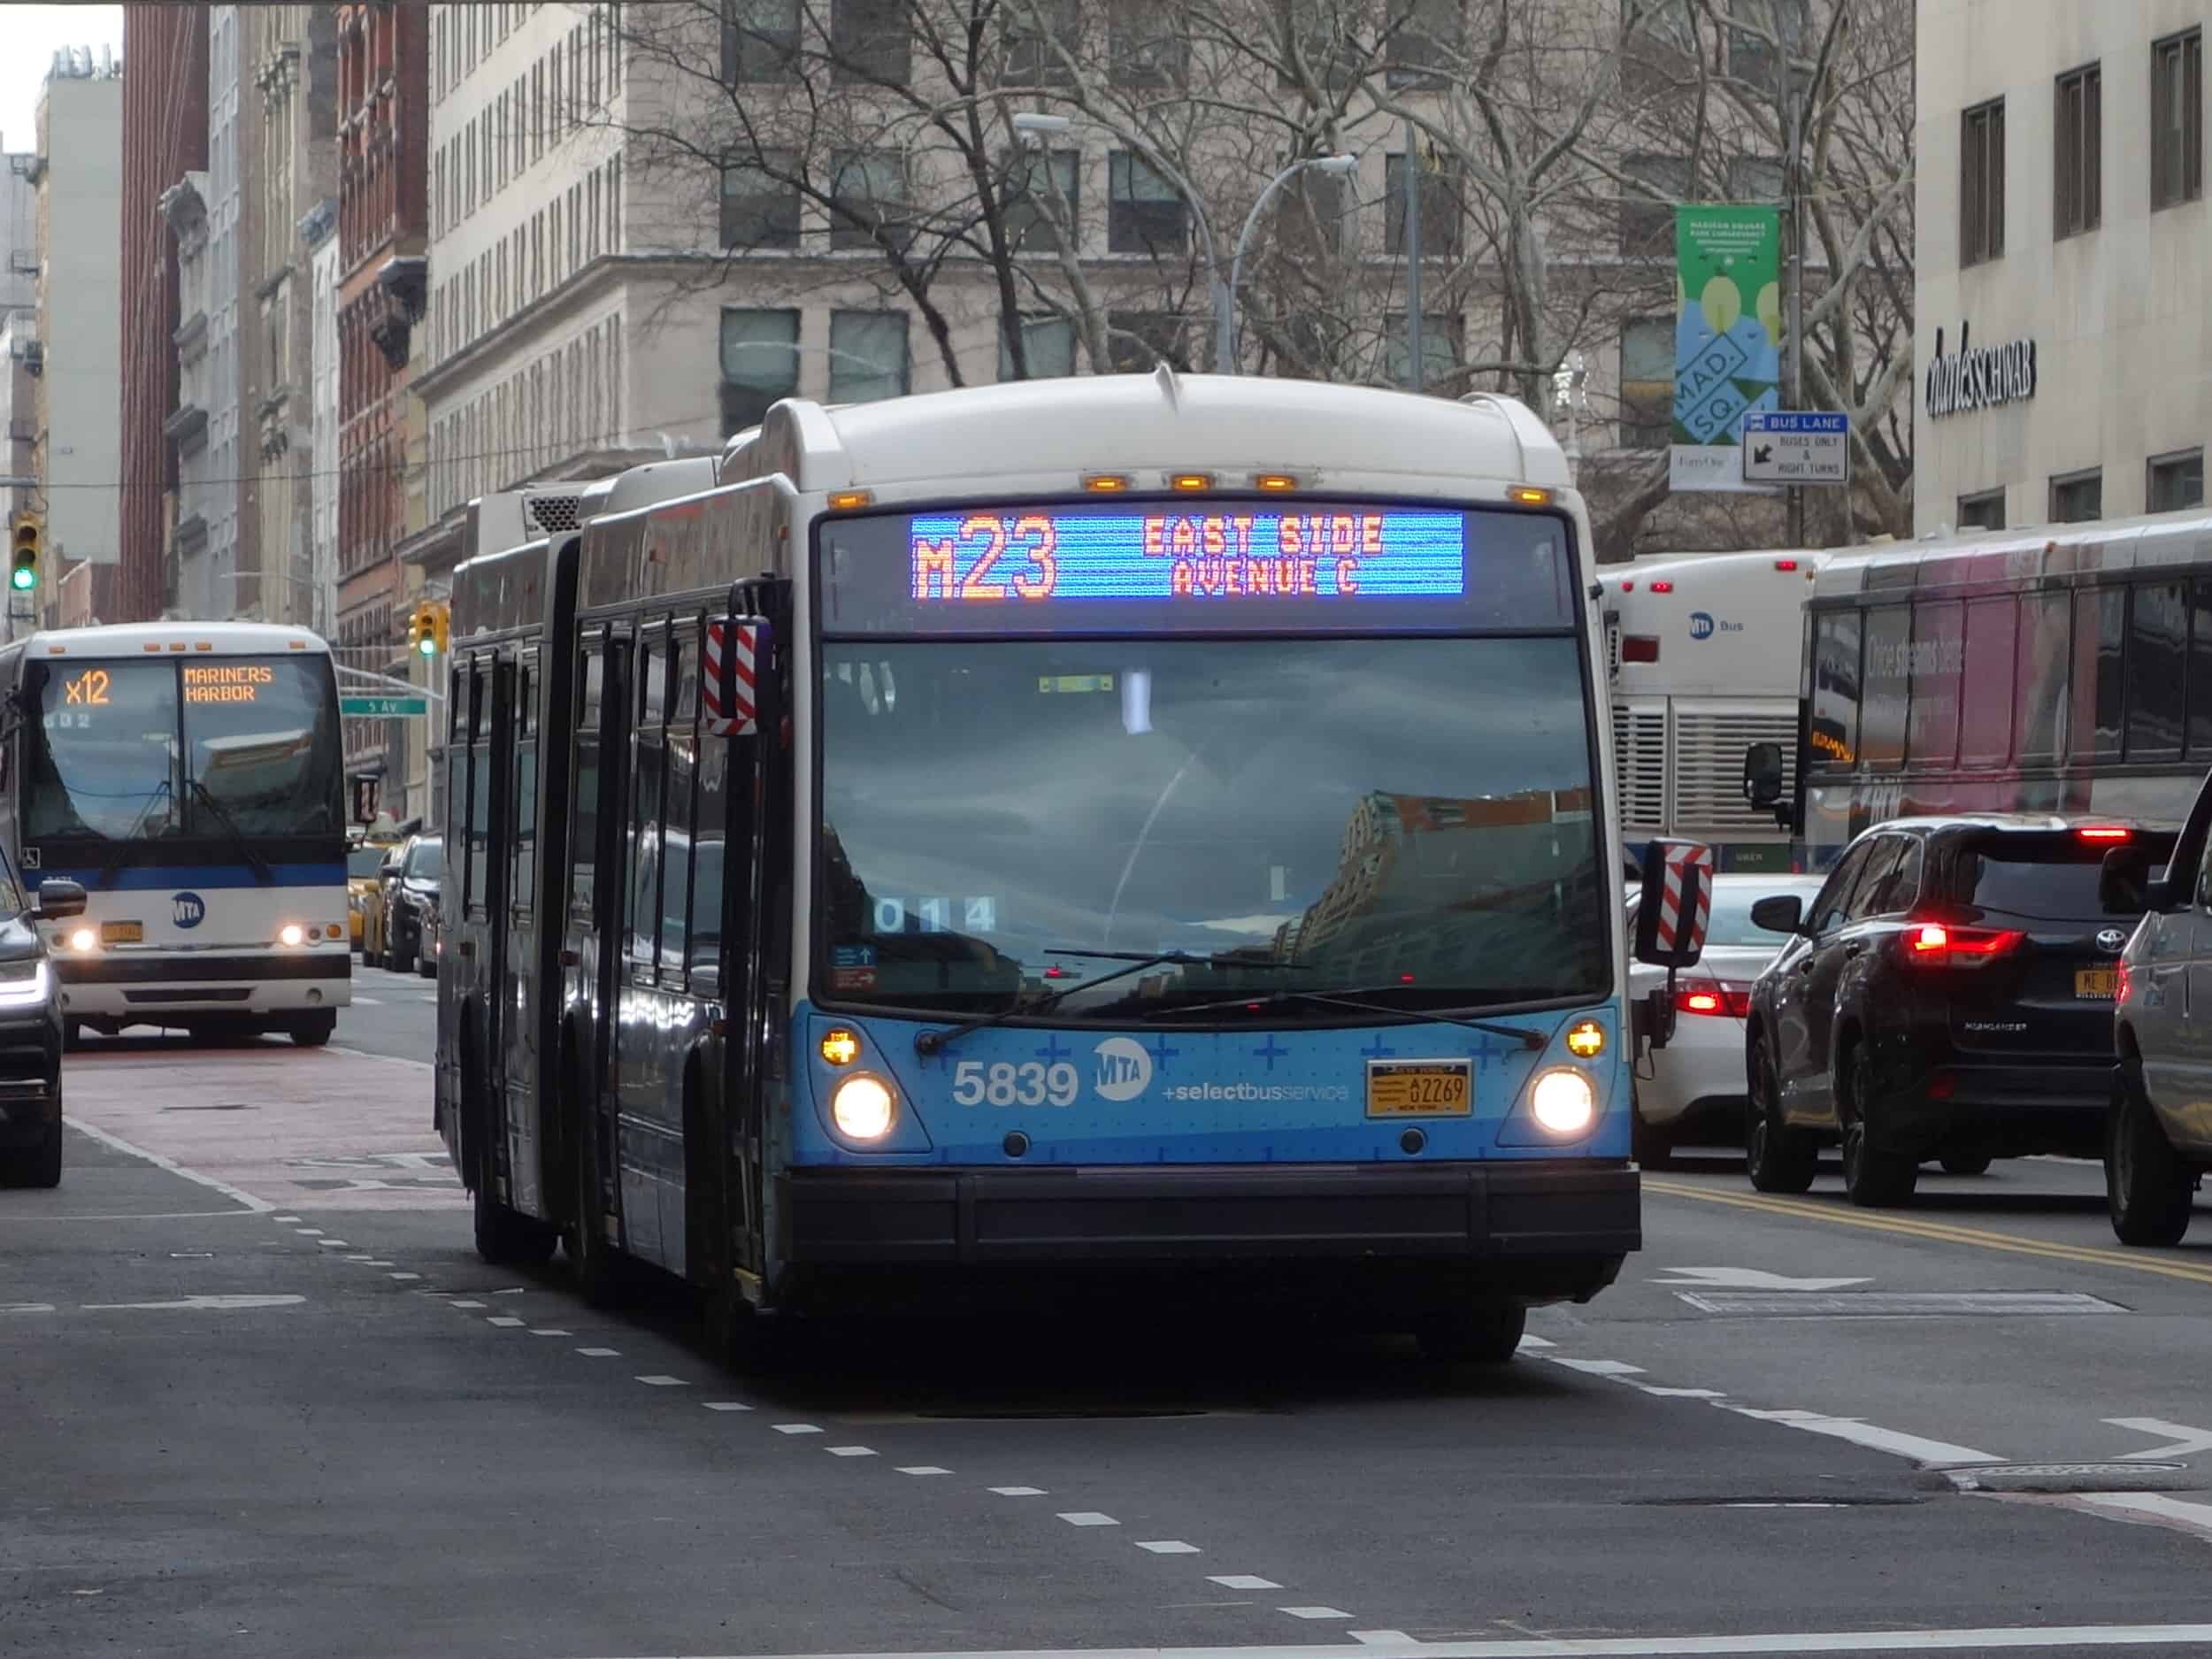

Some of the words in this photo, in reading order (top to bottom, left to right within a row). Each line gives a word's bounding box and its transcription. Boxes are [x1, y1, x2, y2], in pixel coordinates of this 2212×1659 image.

[1674, 353, 1735, 409] MAD.
[1694, 398, 1741, 435] SQ.
[1770, 417, 1799, 429] BUS
[1802, 417, 1841, 429] LANE
[1779, 436, 1809, 447] BUSES
[1815, 436, 1838, 447] ONLY
[1802, 449, 1810, 460] &
[1778, 464, 1805, 475] RIGHT
[1810, 464, 1840, 475] TURNS
[1145, 516, 1252, 555] EAST
[1279, 516, 1383, 555] SIDE
[915, 518, 1055, 597] M23
[1173, 559, 1317, 593] AVENUE
[1338, 559, 1358, 593] C
[184, 667, 273, 683] MARINERS
[185, 686, 256, 703] HARBOR
[953, 1061, 1079, 1106] 5839
